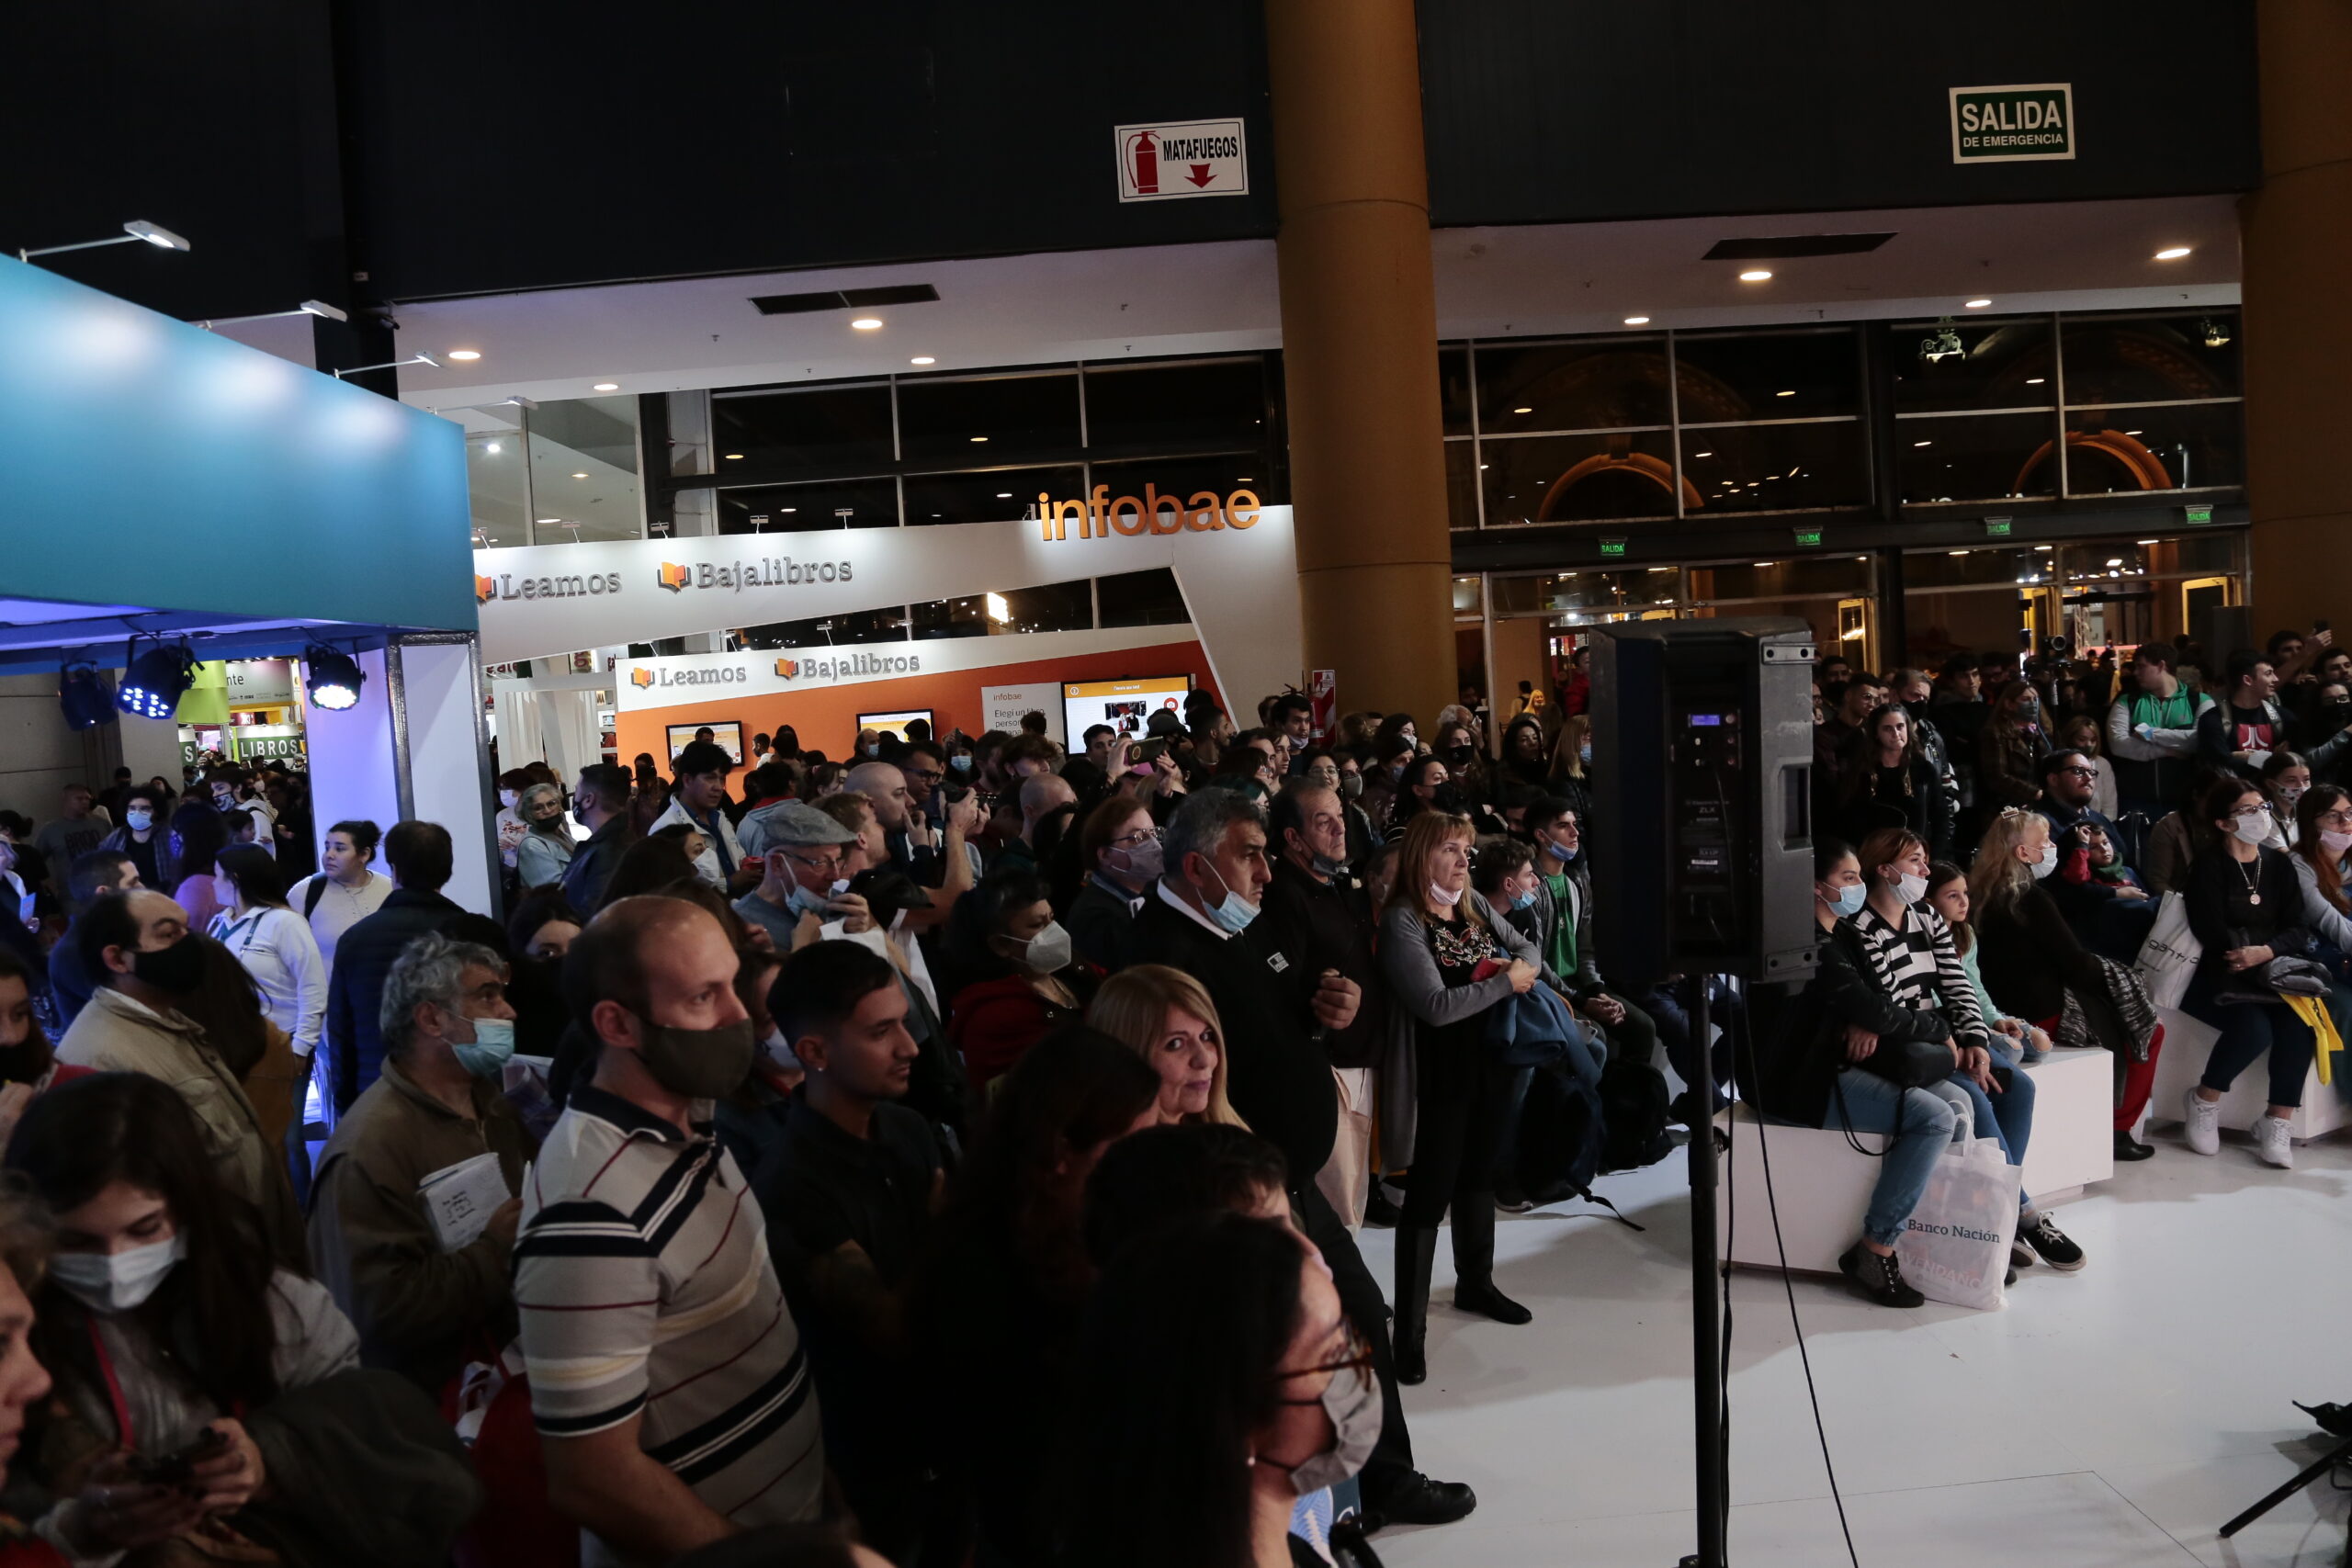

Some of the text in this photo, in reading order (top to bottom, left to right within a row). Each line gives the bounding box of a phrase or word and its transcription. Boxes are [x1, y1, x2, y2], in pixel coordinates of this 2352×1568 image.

[1962, 100, 2064, 132] SALIDA
[1162, 136, 1238, 161] MATAFUEGOS
[1962, 133, 2064, 148] DE EMERGENCIA
[1038, 482, 1261, 541] infobae
[501, 570, 621, 600] Leamos
[695, 556, 853, 594] Bajalibros
[227, 674, 244, 686] nte
[660, 664, 747, 687] Leamos
[801, 652, 922, 683] Bajalibros
[993, 693, 1022, 702] infobae
[185, 745, 194, 762] S
[240, 739, 299, 758] LIBROS
[1907, 1219, 2001, 1244] Banco Nación
